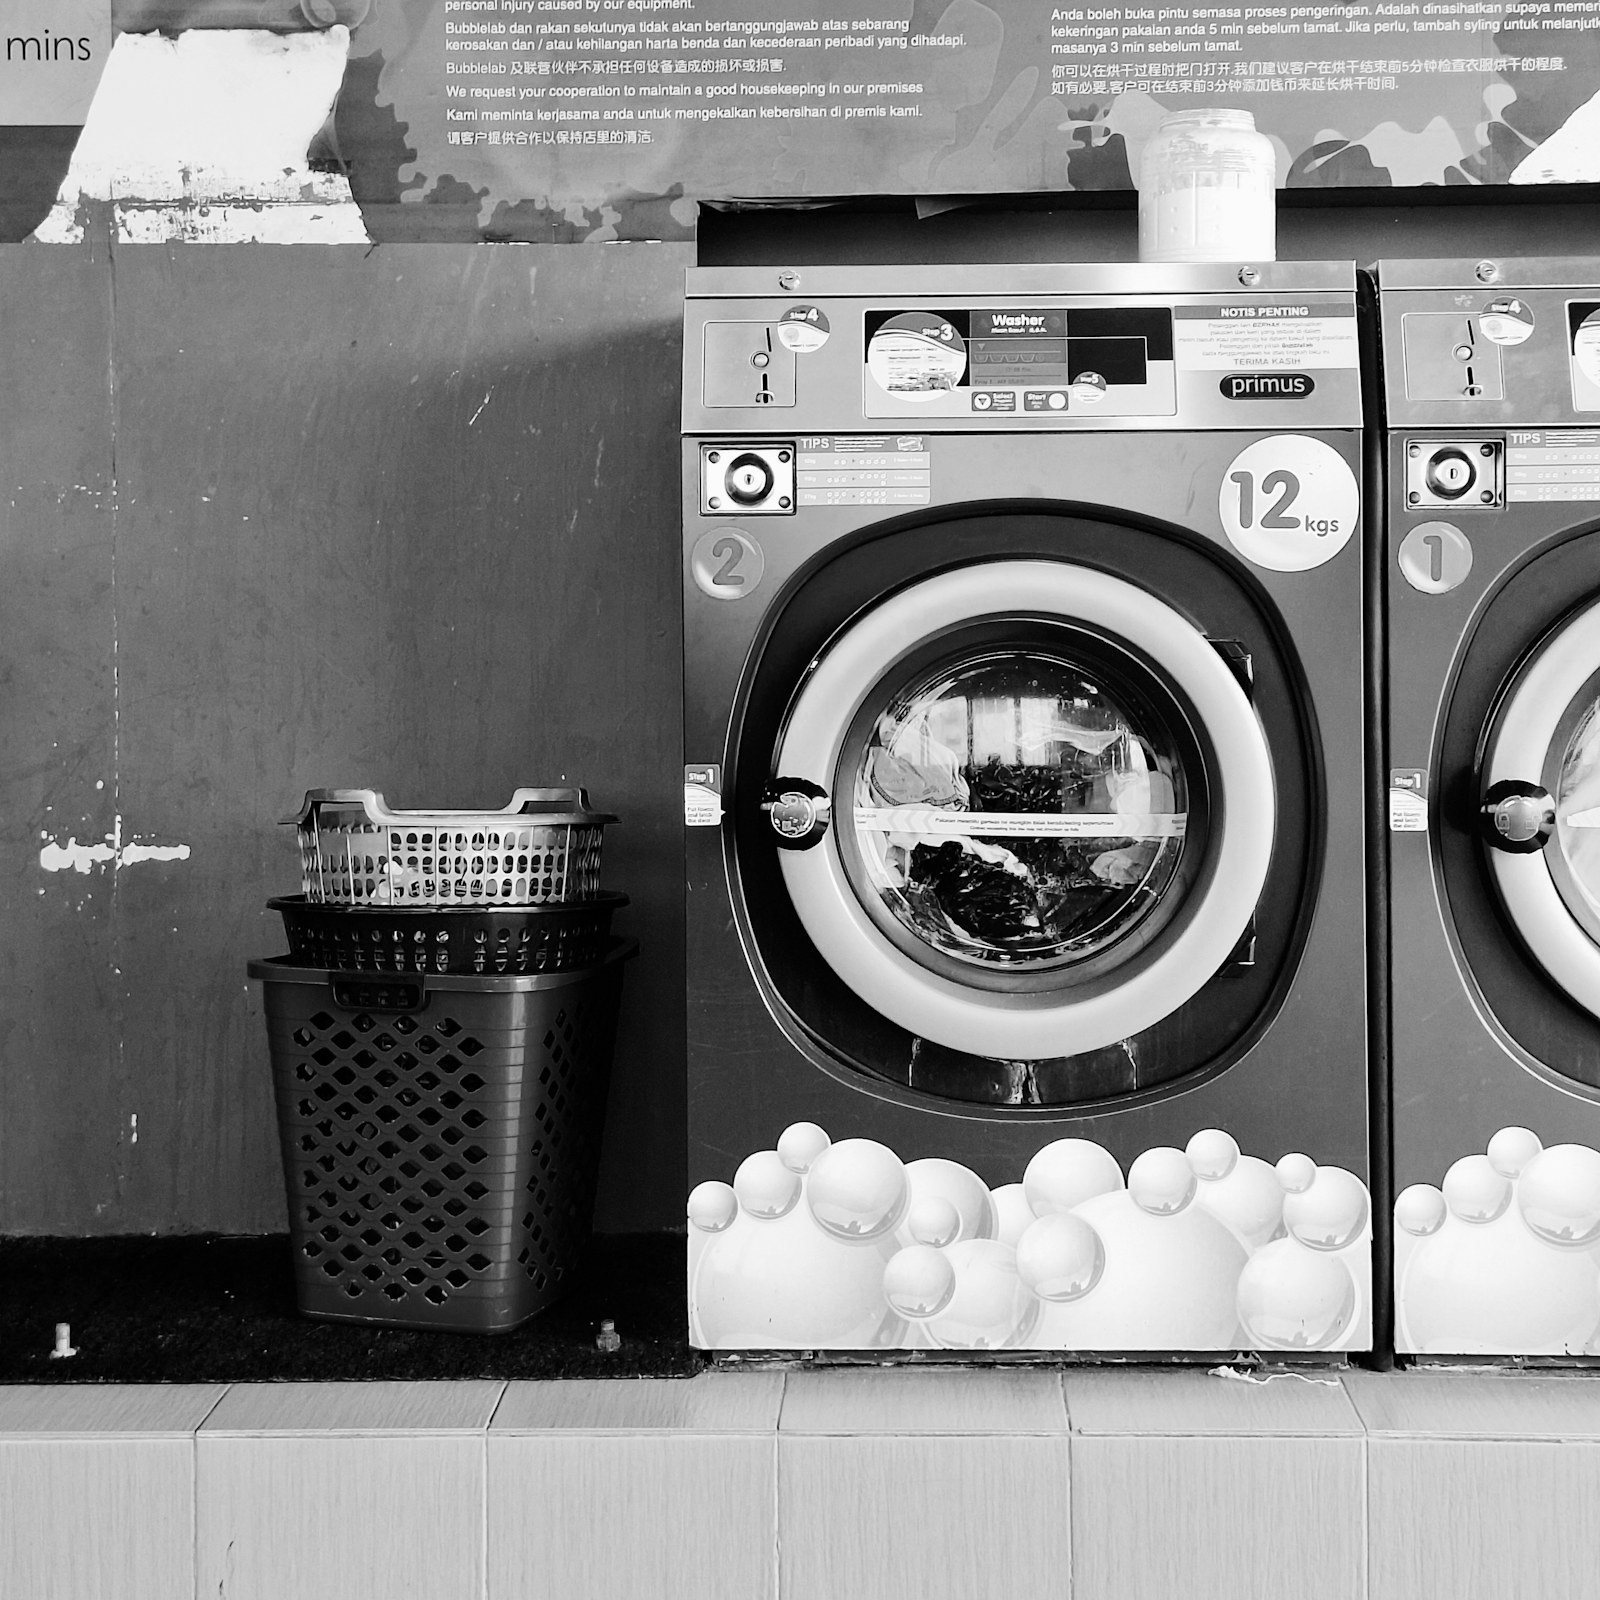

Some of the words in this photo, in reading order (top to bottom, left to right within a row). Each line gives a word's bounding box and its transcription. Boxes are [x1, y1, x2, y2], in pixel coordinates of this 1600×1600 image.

[445, 0, 497, 14] personal
[502, 0, 534, 14] injury
[538, 0, 582, 11] caused
[586, 0, 600, 13] by
[604, 0, 624, 10] our
[627, 0, 695, 13] equipment.
[1051, 8, 1083, 21] Anda
[1087, 7, 1121, 20] boleh
[1125, 7, 1155, 20] buka
[1159, 6, 1188, 22] pintu
[1193, 8, 1241, 19] semasa
[1245, 7, 1287, 20] proses
[1291, 3, 1372, 20] pengeringan.
[1375, 2, 1419, 16] Adalah
[1423, 1, 1502, 15] dinasihatkan
[1505, 2, 1551, 16] supaya
[446, 21, 506, 34] Bubblelab
[509, 21, 532, 35] dan
[536, 21, 570, 35] rakan
[574, 21, 635, 36] sekutunya
[640, 20, 668, 33] tidak
[672, 20, 701, 33] akan
[706, 18, 818, 35] bertanggungjawab
[822, 18, 848, 31] atas
[852, 17, 909, 33] sebarang
[1052, 24, 1118, 40] kekeringan
[1122, 23, 1170, 39] pakaian
[1174, 22, 1205, 36] anda
[1209, 23, 1217, 35] 5
[1221, 22, 1243, 35] min
[1247, 21, 1300, 35] sebelum
[1304, 21, 1342, 34] tamat.
[1345, 20, 1370, 33] Jika
[1374, 19, 1409, 35] perlu,
[1413, 19, 1460, 32] tambah
[1464, 18, 1500, 34] syling
[1504, 17, 1539, 31] untuk
[7, 29, 91, 61] mins
[446, 38, 508, 51] kerosakan
[512, 38, 534, 51] dan
[538, 38, 543, 51] /
[546, 39, 573, 51] atau
[577, 37, 642, 53] kehilangan
[646, 37, 678, 50] harta
[682, 36, 720, 49] benda
[723, 36, 746, 49] dan
[750, 35, 821, 48] kecederaan
[825, 34, 874, 50] peribadi
[878, 36, 907, 50] yang
[911, 33, 966, 49] dihadapi.
[1051, 43, 1107, 57] masanya
[1111, 41, 1118, 53] 3
[1122, 41, 1144, 53] min
[1148, 39, 1200, 53] sebelum
[1204, 39, 1242, 52] tamat.
[447, 62, 506, 73] Bubblelab
[446, 84, 466, 98] We
[471, 85, 515, 100] request
[519, 87, 546, 100] your
[549, 84, 620, 99] cooperation
[624, 84, 635, 97] to
[639, 83, 691, 97] maintain
[695, 85, 702, 96] a
[706, 82, 736, 99] good
[741, 81, 825, 98] housekeeping
[829, 81, 840, 94] in
[844, 84, 864, 94] our
[867, 81, 923, 97] premises
[447, 108, 477, 121] Kami
[482, 108, 533, 121] meminta
[537, 108, 600, 123] kerjasama
[603, 107, 634, 121] anda
[638, 107, 672, 120] untuk
[675, 106, 756, 122] mengekalkan
[760, 105, 826, 119] kebersihan
[831, 105, 841, 118] di
[845, 104, 886, 120] premis
[890, 104, 922, 117] kami.
[807, 307, 819, 321] 4
[991, 313, 1045, 326] Washer
[1220, 307, 1255, 317] NOTIS
[1258, 305, 1310, 316] PENTING
[940, 323, 953, 341] 3
[1232, 375, 1305, 397] primus
[800, 437, 830, 449] TIPS
[1510, 433, 1541, 444] TIPS
[1230, 469, 1301, 529] 12
[1305, 515, 1339, 537] kgs
[712, 538, 745, 586] 2
[1423, 536, 1442, 582] 1
[707, 768, 714, 784] 1
[1413, 773, 1421, 789] 1
